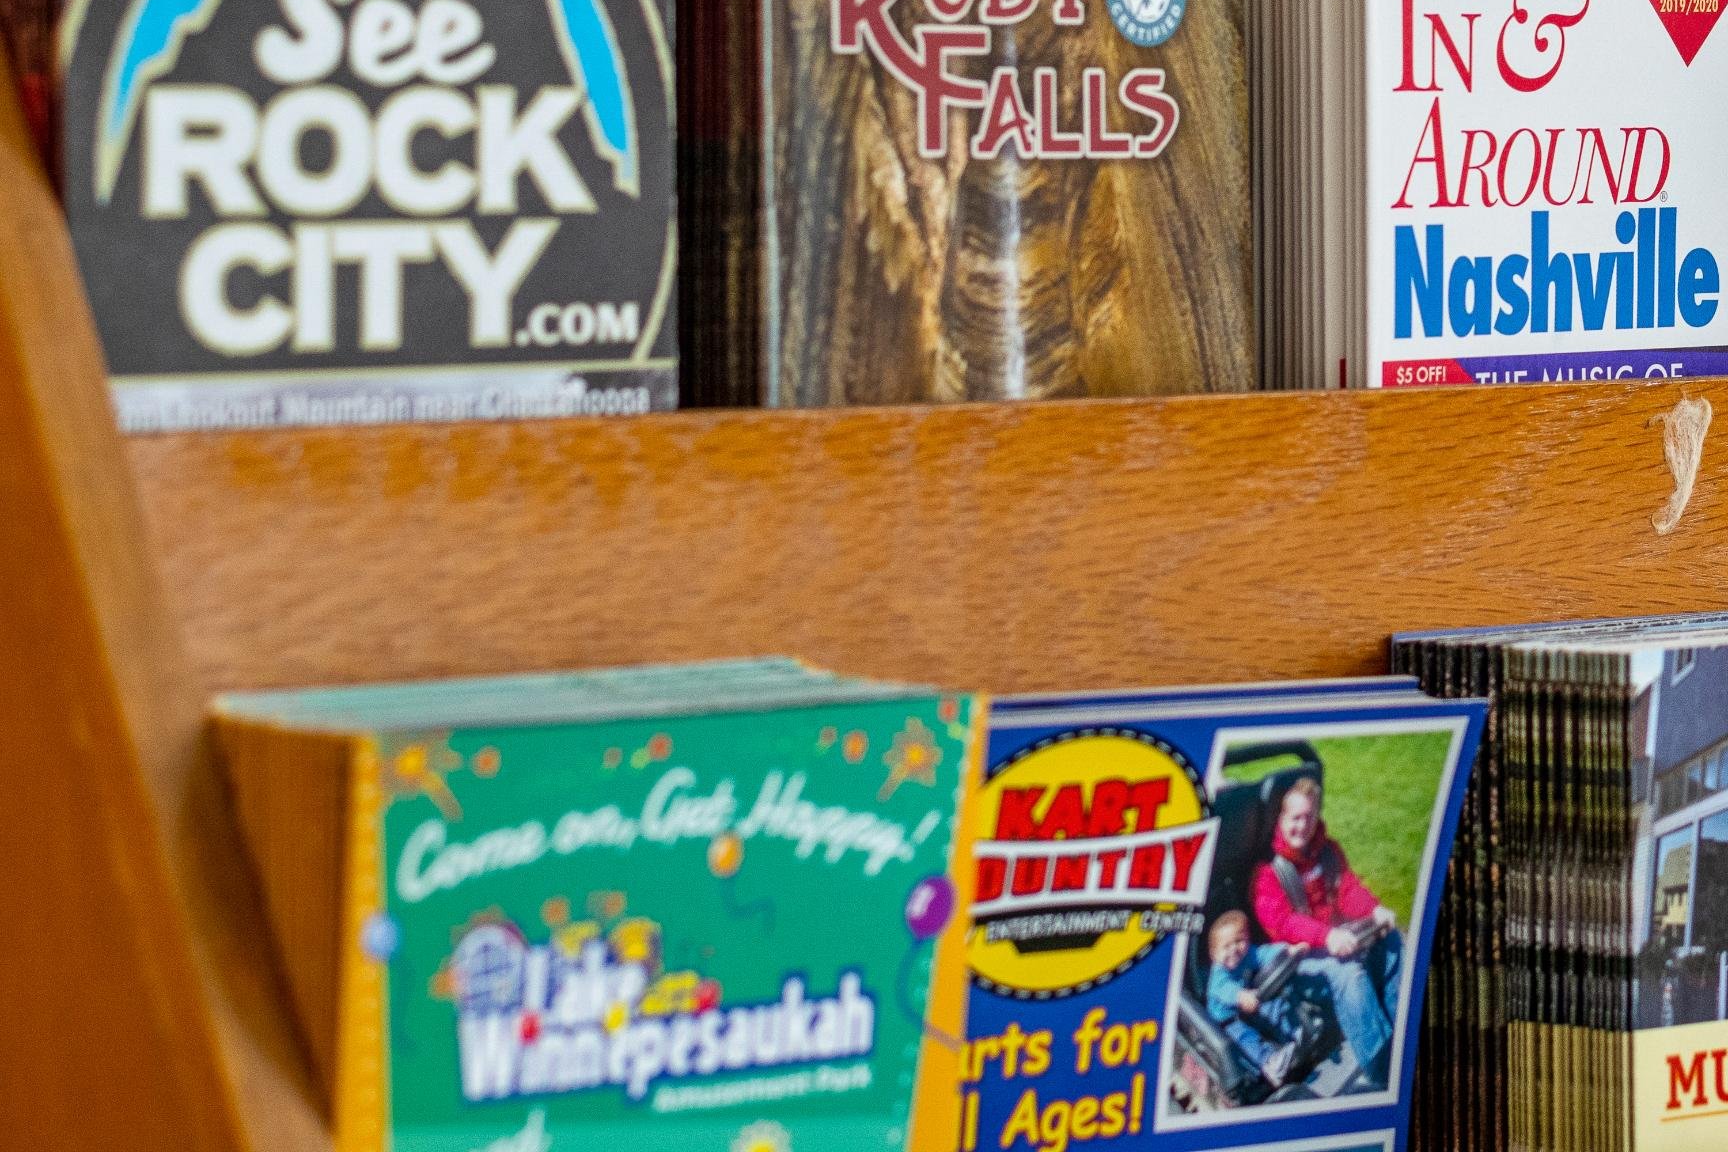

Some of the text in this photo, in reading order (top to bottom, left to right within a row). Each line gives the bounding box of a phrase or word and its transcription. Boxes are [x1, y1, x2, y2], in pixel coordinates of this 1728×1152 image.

[916, 22, 1181, 160] FALLS
[142, 82, 598, 219] ROCK
[1393, 206, 1720, 339] Nashville
[1395, 365, 1448, 386] $5 OFF!
[394, 818, 547, 902] Come
[638, 765, 738, 845] Get
[736, 769, 943, 876] Happy!
[995, 776, 1171, 842] KART
[985, 909, 1206, 943] ENTERTAINMENT CENTER
[1072, 1005, 1159, 1075] for
[1000, 1071, 1147, 1152] Ages!
